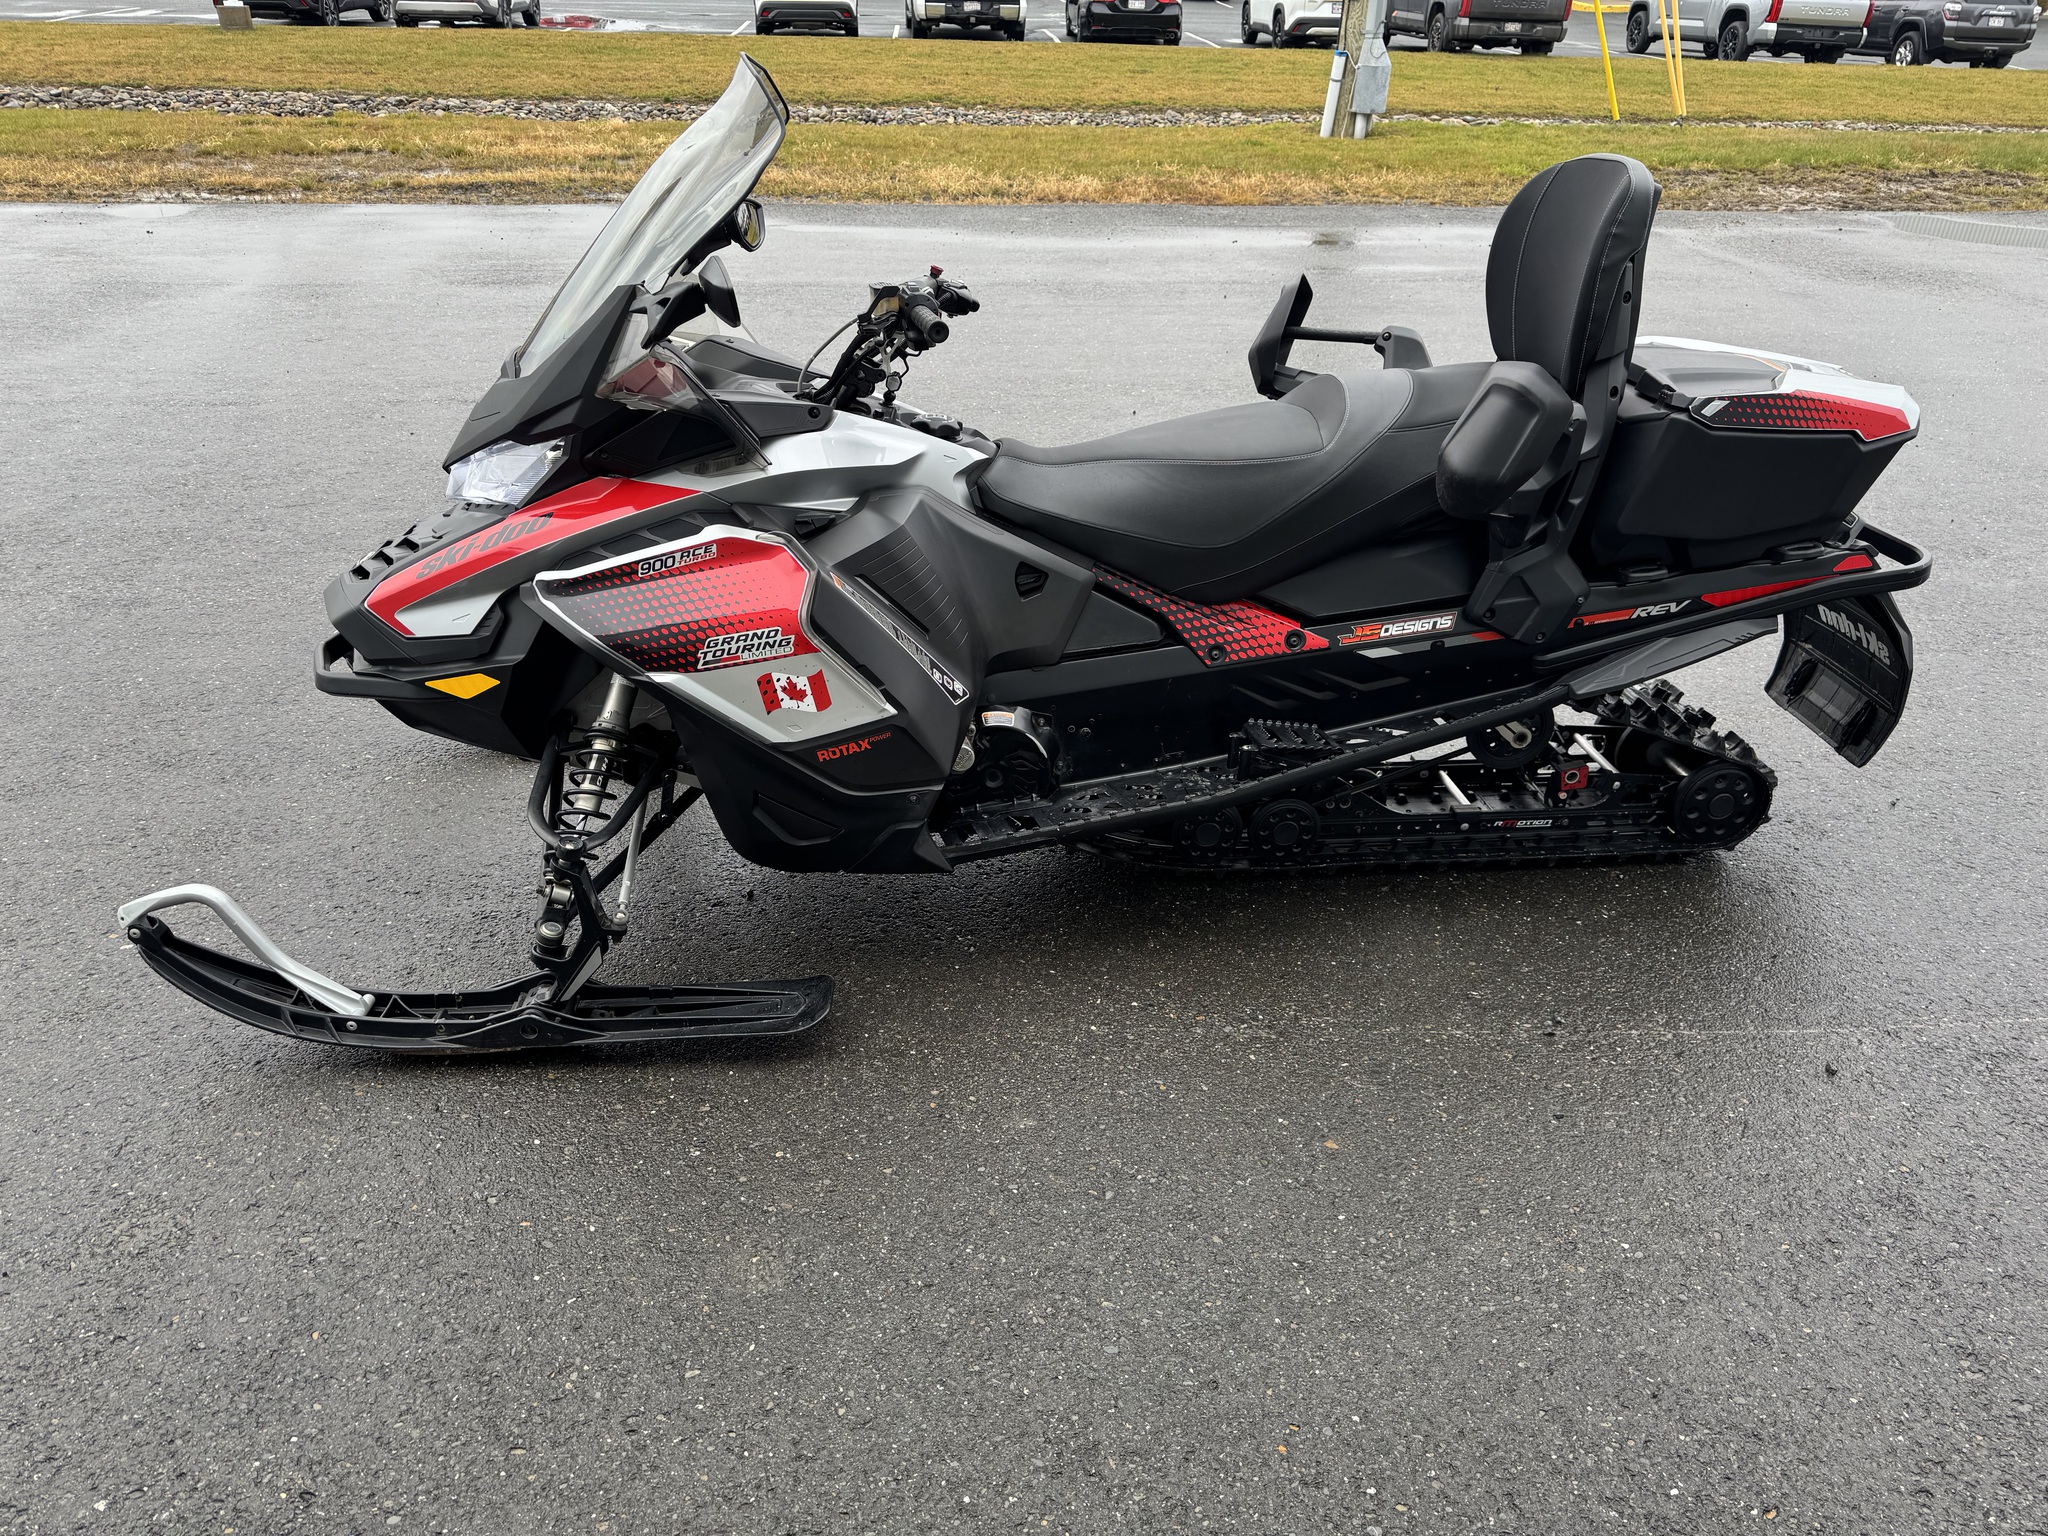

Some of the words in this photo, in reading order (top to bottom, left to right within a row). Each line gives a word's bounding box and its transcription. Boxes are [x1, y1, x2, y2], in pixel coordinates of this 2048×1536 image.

[1493, 0, 1546, 9] TUNDRA
[1801, 5, 1851, 16] TUNDRA
[640, 555, 676, 575] 900
[680, 544, 714, 559] ACE
[677, 552, 715, 565] TURBO
[1630, 599, 1691, 619] REV
[700, 637, 792, 660] TOURING
[706, 629, 780, 650] GRAND
[741, 646, 793, 660] LIMITED
[817, 738, 872, 762] ROTAX
[869, 731, 892, 743] POWER
